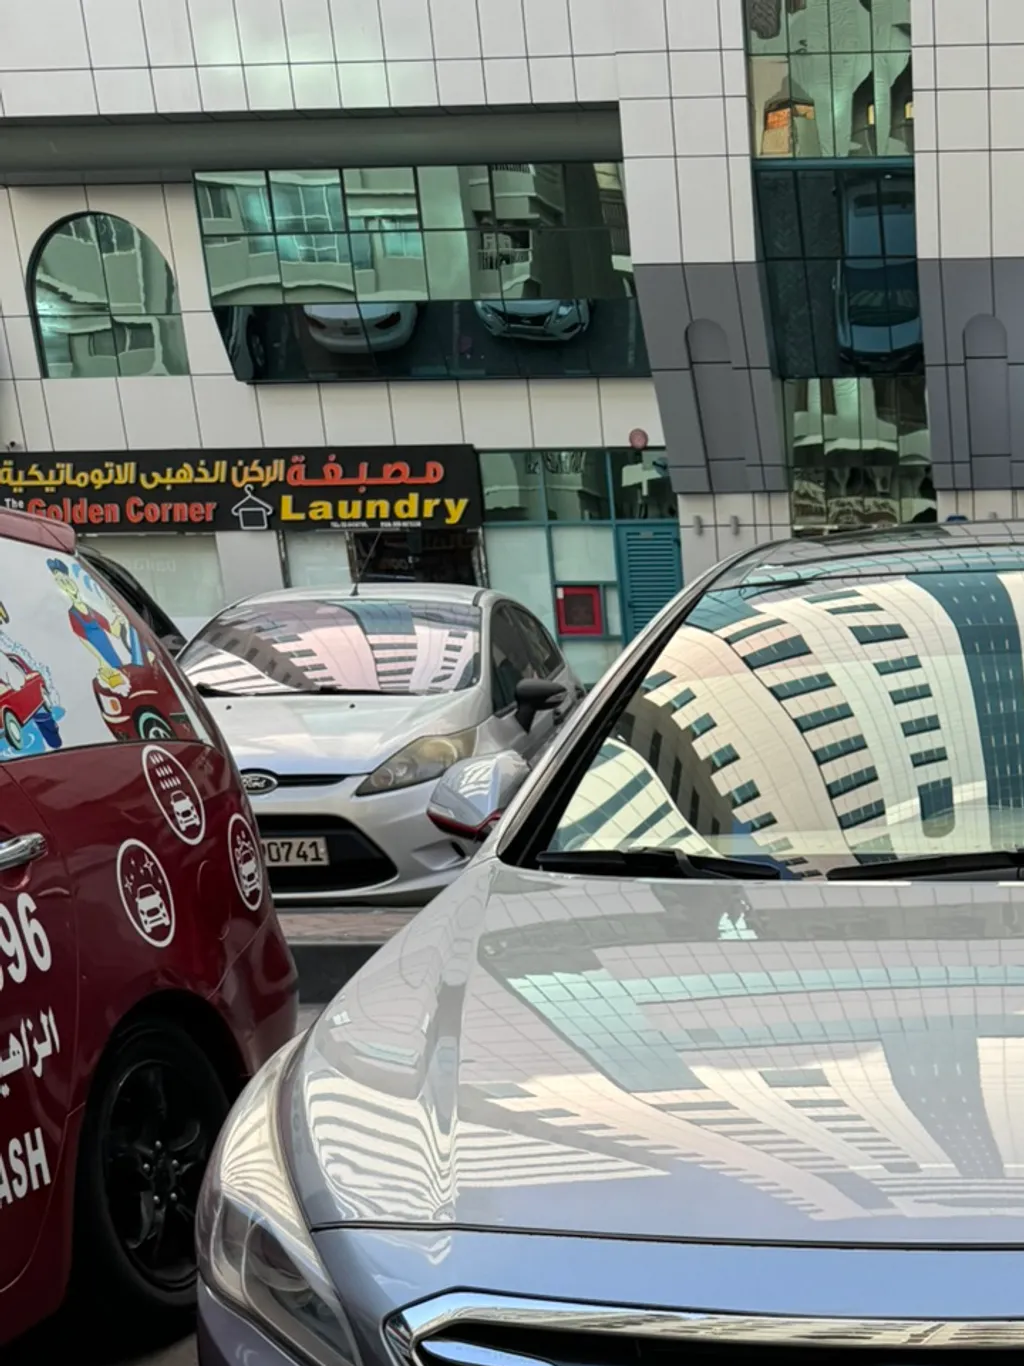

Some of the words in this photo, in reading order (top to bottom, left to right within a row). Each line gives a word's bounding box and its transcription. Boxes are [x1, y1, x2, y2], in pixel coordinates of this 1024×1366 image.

[231, 459, 285, 488] الركن
[286, 454, 444, 493] مصبغة
[5, 497, 25, 509] The
[27, 497, 120, 524] Golden
[125, 496, 217, 523] Corner
[281, 492, 469, 525] Laundry
[262, 841, 324, 862] 0741
